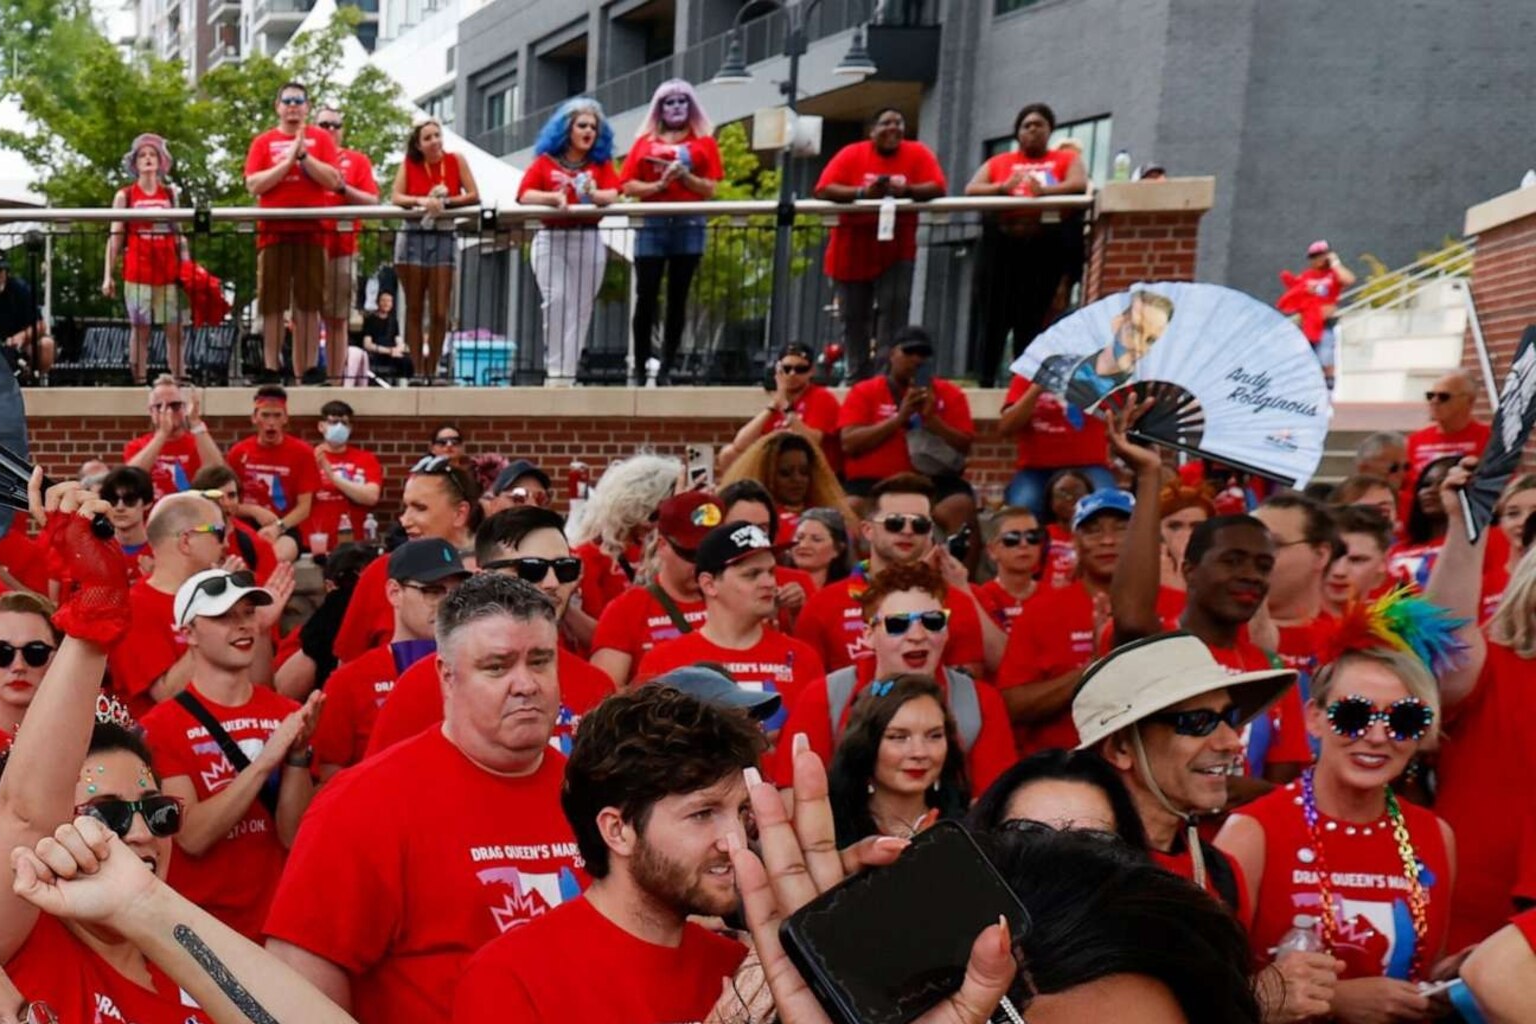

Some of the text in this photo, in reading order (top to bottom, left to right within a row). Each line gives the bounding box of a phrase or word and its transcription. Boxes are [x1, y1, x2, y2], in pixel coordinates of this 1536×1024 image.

[1226, 367, 1272, 393] Andy
[1227, 386, 1317, 417] Rodginous
[186, 725, 210, 740] DRA
[470, 847, 504, 861] DRAG
[504, 844, 550, 859] QUEEN'S
[1292, 870, 1320, 884] DRA
[1330, 873, 1387, 889] QUEEN'S
